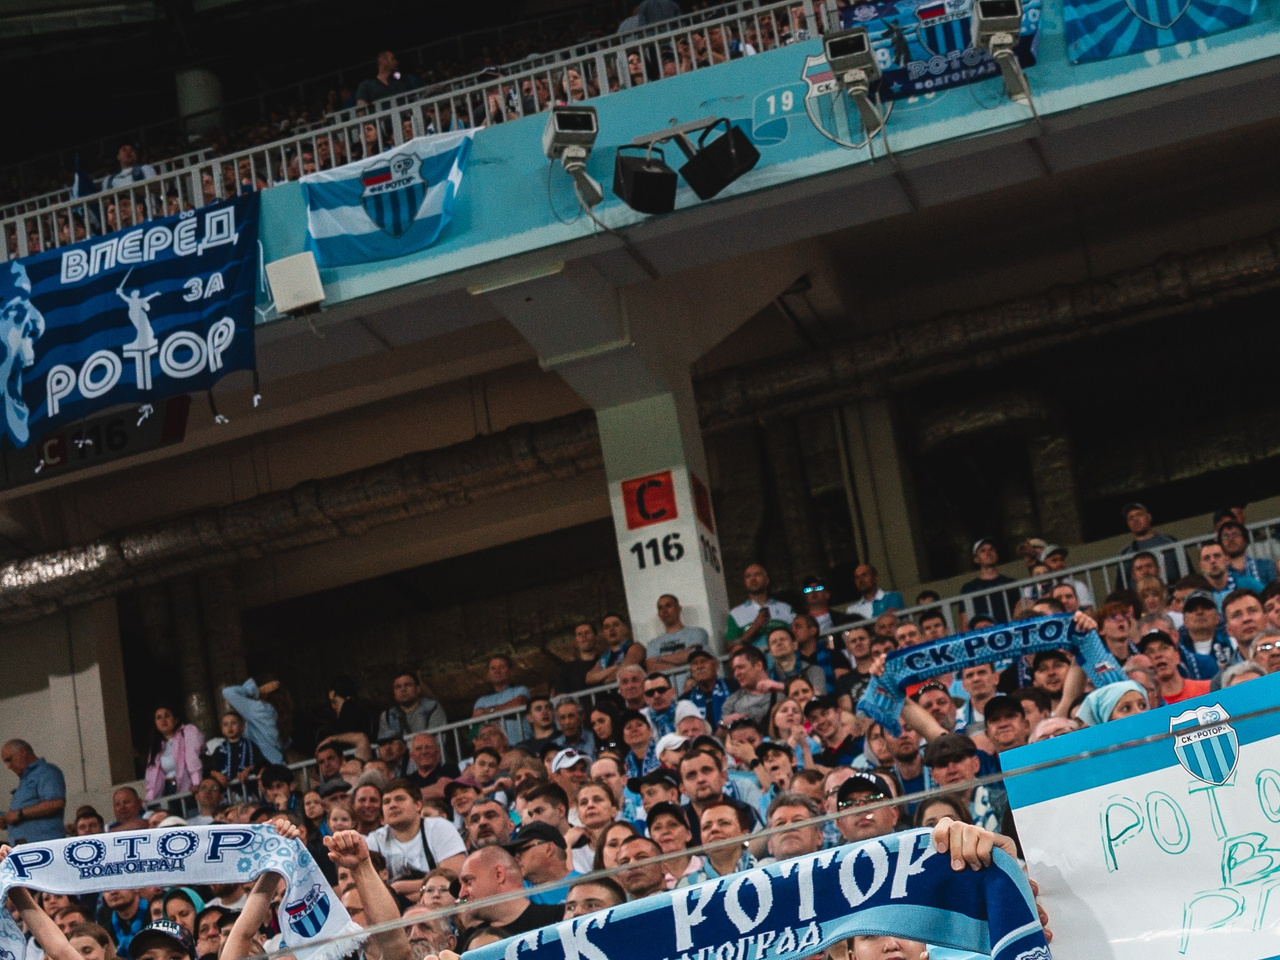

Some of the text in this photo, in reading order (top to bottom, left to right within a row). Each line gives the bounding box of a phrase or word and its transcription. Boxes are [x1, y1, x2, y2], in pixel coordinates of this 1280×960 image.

[907, 47, 996, 80] РОТО
[765, 90, 794, 115] 19
[60, 206, 239, 284] ВПЕРЁД
[183, 272, 225, 302] ЗА
[46, 316, 236, 418] РОТОР
[630, 532, 685, 570] 116
[905, 642, 958, 672] СК
[1181, 735, 1193, 744] СК
[8, 827, 256, 879] РОТОР
[79, 857, 186, 880] ВОЛГОГРАД
